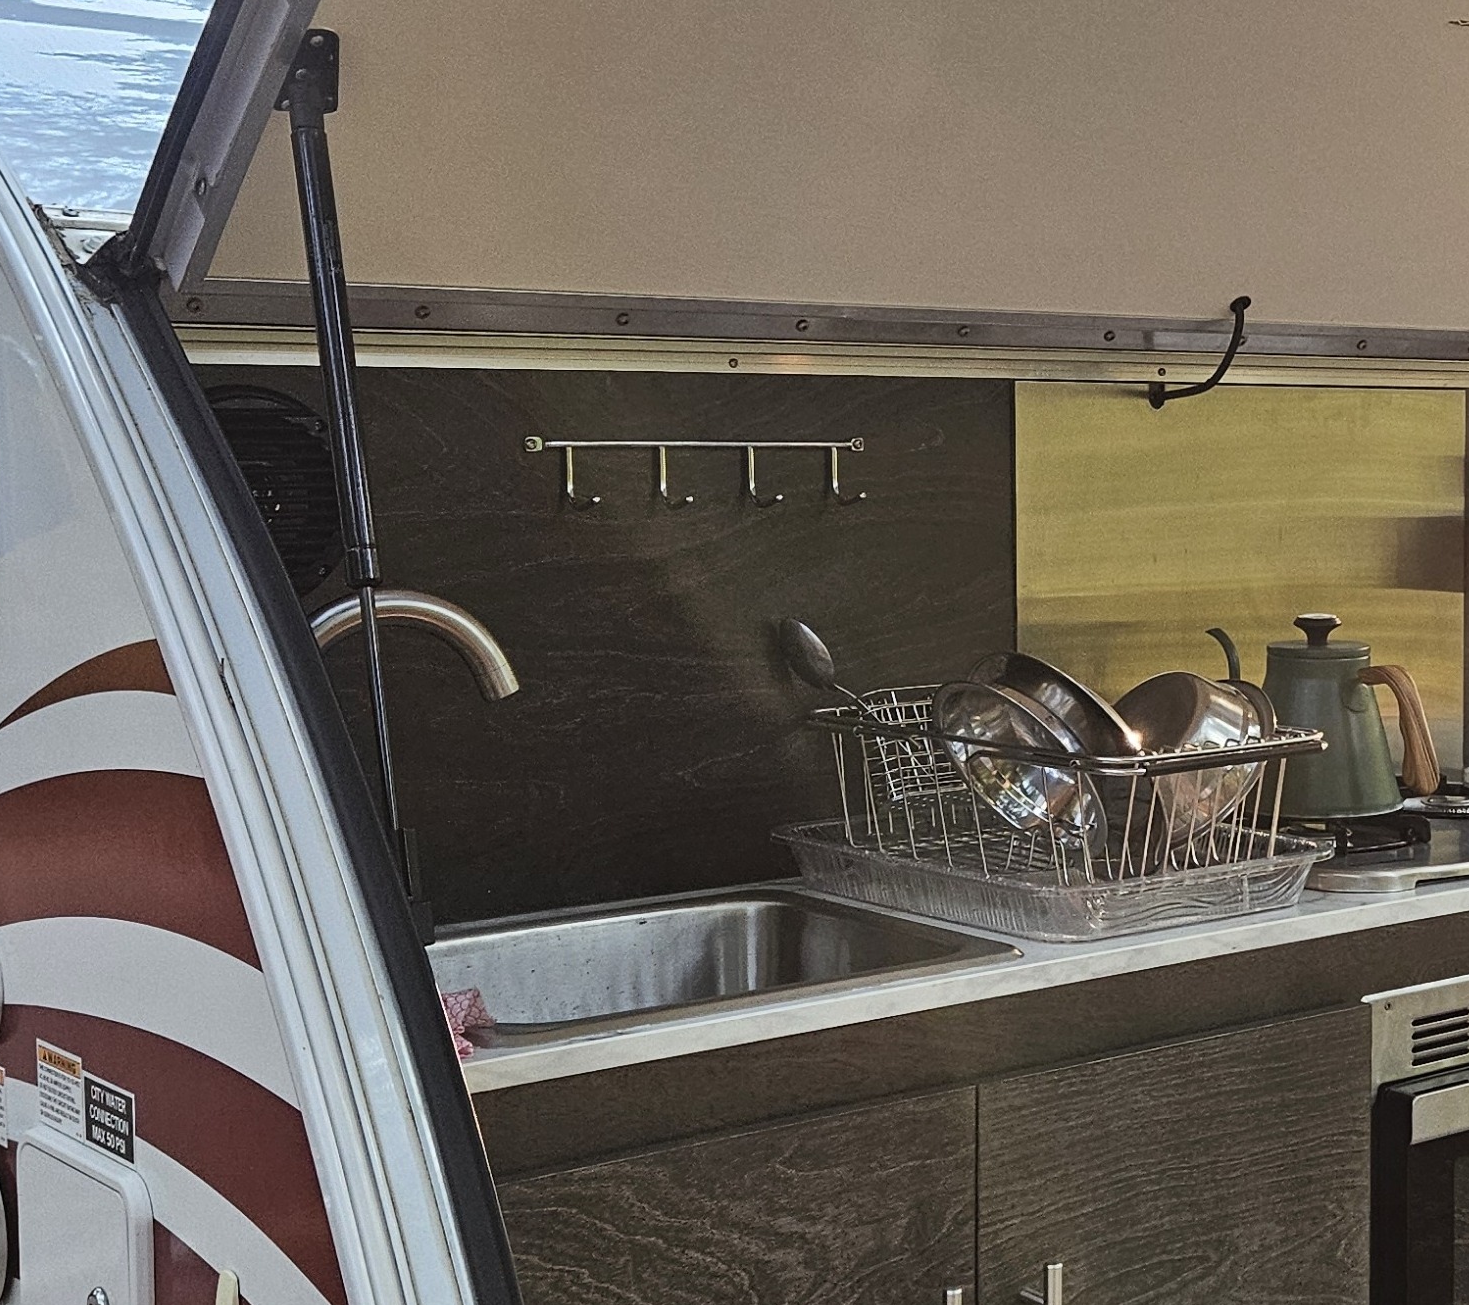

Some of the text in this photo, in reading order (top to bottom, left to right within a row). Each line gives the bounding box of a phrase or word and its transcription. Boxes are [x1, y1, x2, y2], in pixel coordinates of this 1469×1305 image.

[91, 1085, 127, 1115] CITY WATER
[89, 1104, 129, 1136] CONNECTION
[92, 1124, 126, 1154] MAX 50 PSI
